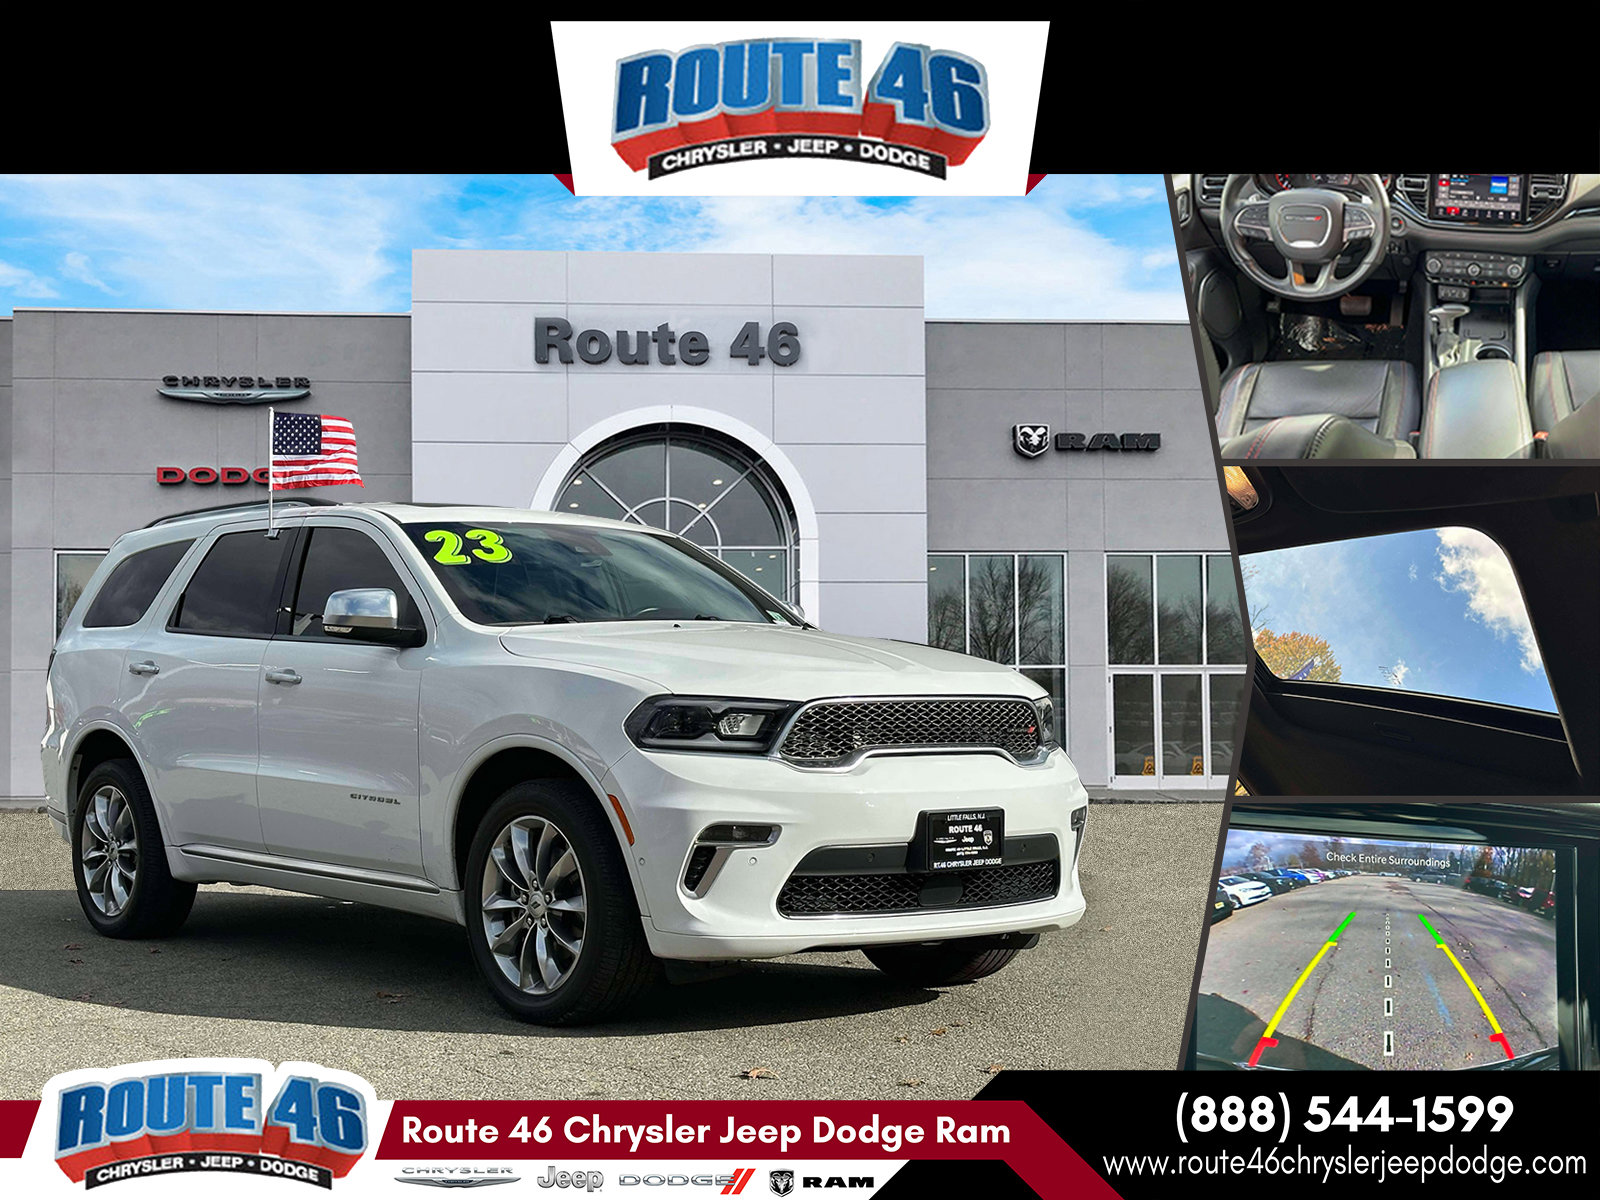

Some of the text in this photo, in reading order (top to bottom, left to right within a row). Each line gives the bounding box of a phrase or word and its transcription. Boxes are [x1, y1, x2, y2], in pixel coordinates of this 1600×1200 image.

[534, 317, 801, 367] Route 46
[162, 375, 311, 388] CHRYSLER
[1054, 432, 1161, 451] RAM
[156, 466, 270, 485] DODG
[424, 529, 513, 566] 23
[949, 824, 983, 834] ROUTE 46
[947, 860, 972, 868] CHRYSLER
[973, 859, 984, 867] JEEP
[1326, 851, 1451, 869] Check Entire Surroundings
